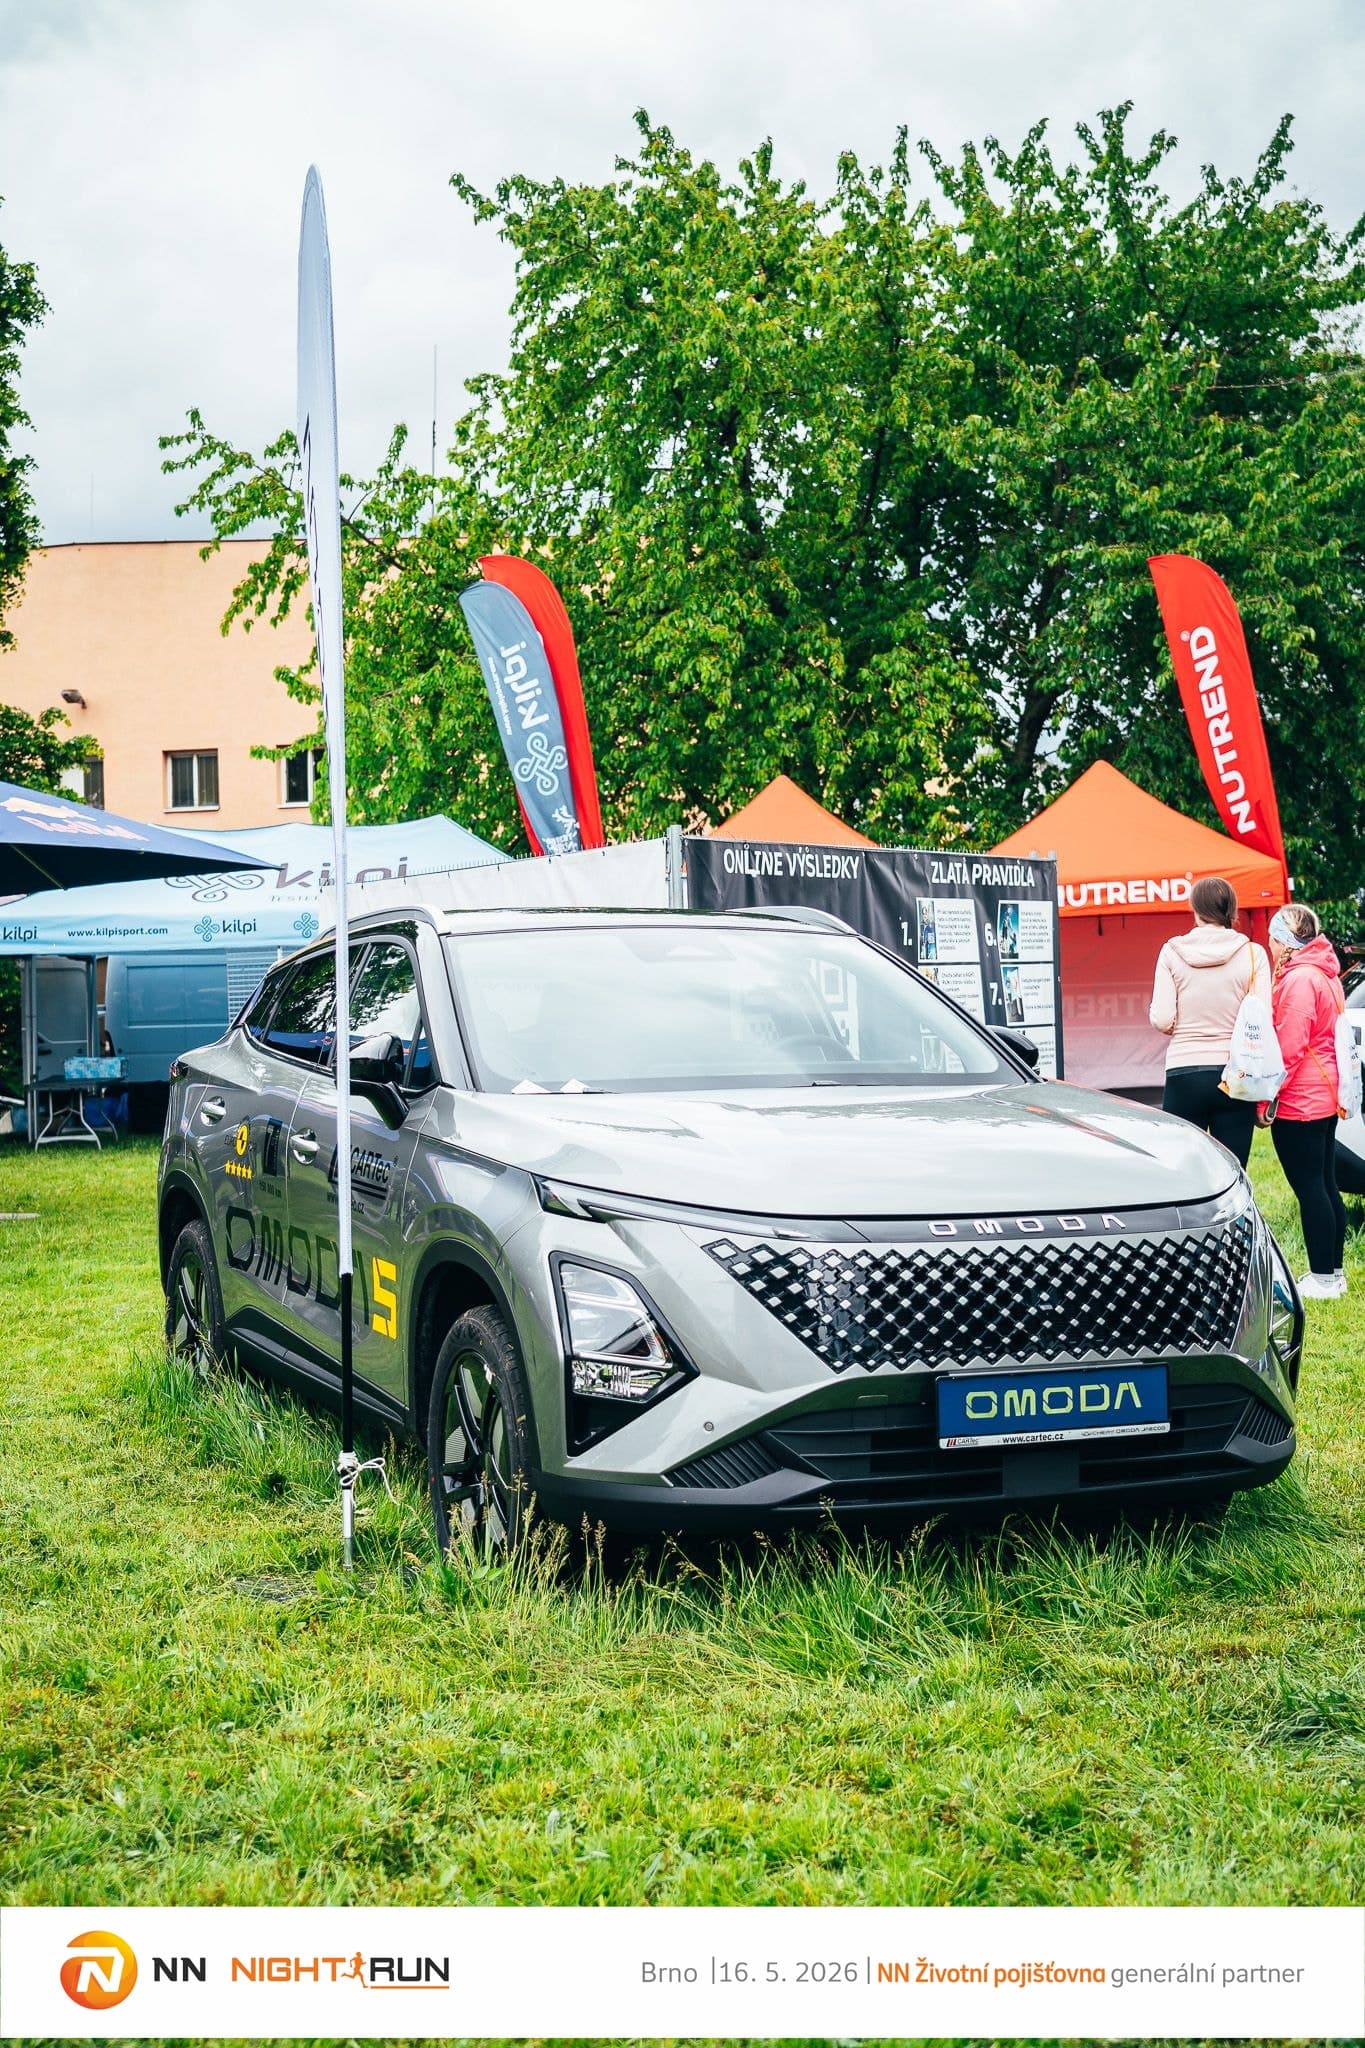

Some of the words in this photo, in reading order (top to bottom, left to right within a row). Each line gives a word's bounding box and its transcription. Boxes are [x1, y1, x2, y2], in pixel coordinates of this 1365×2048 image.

[1189, 626, 1256, 834] NUTREND
[276, 856, 408, 889] kii
[723, 848, 783, 877] ONLINE
[785, 846, 860, 879] VÝSLEDKY
[930, 856, 970, 885] ZLATÁ
[972, 863, 1035, 887] PRAVIDLA
[3, 926, 38, 942] kilpi
[67, 927, 169, 938] www.kilpisport.com
[222, 918, 257, 933] kilpi
[901, 921, 913, 946] 1.
[984, 922, 997, 947] 6.
[989, 982, 1003, 1006] 7.
[928, 1213, 1126, 1237] OMODA
[372, 1256, 397, 1340] 5
[965, 1381, 1142, 1419] OMODA
[1002, 1432, 1065, 1444] www.cartec.cz
